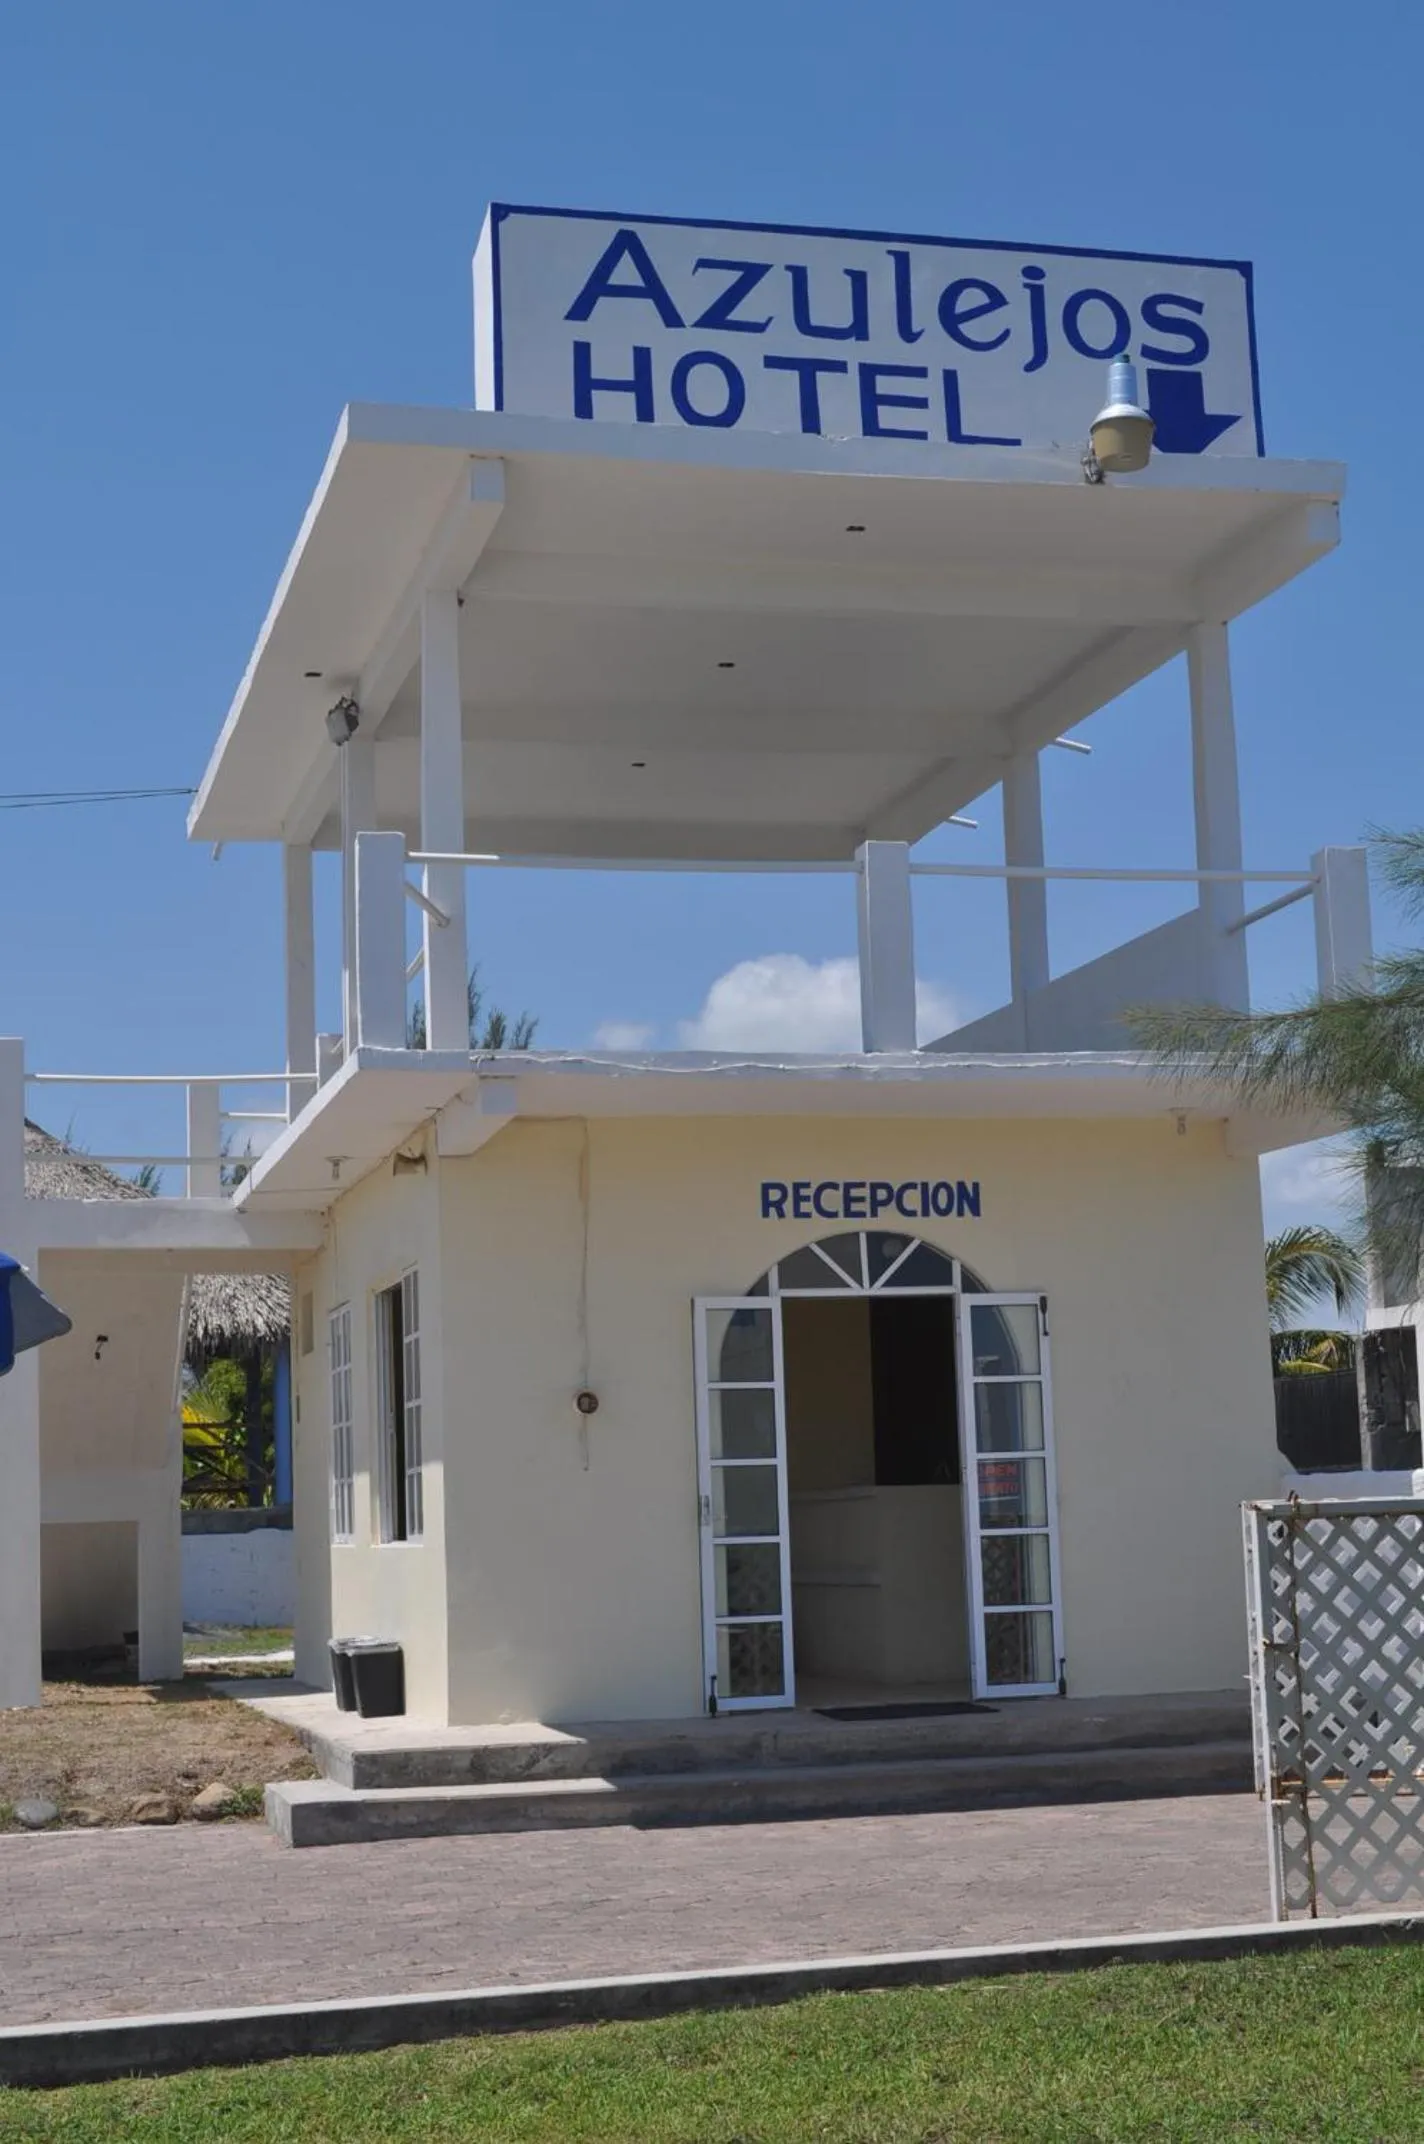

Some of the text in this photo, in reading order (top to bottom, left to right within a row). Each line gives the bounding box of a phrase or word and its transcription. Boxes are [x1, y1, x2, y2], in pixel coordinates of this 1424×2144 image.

[564, 228, 1210, 373] Azulejos
[573, 340, 1022, 447] HOTEL
[761, 1181, 981, 1218] RECEPCION
